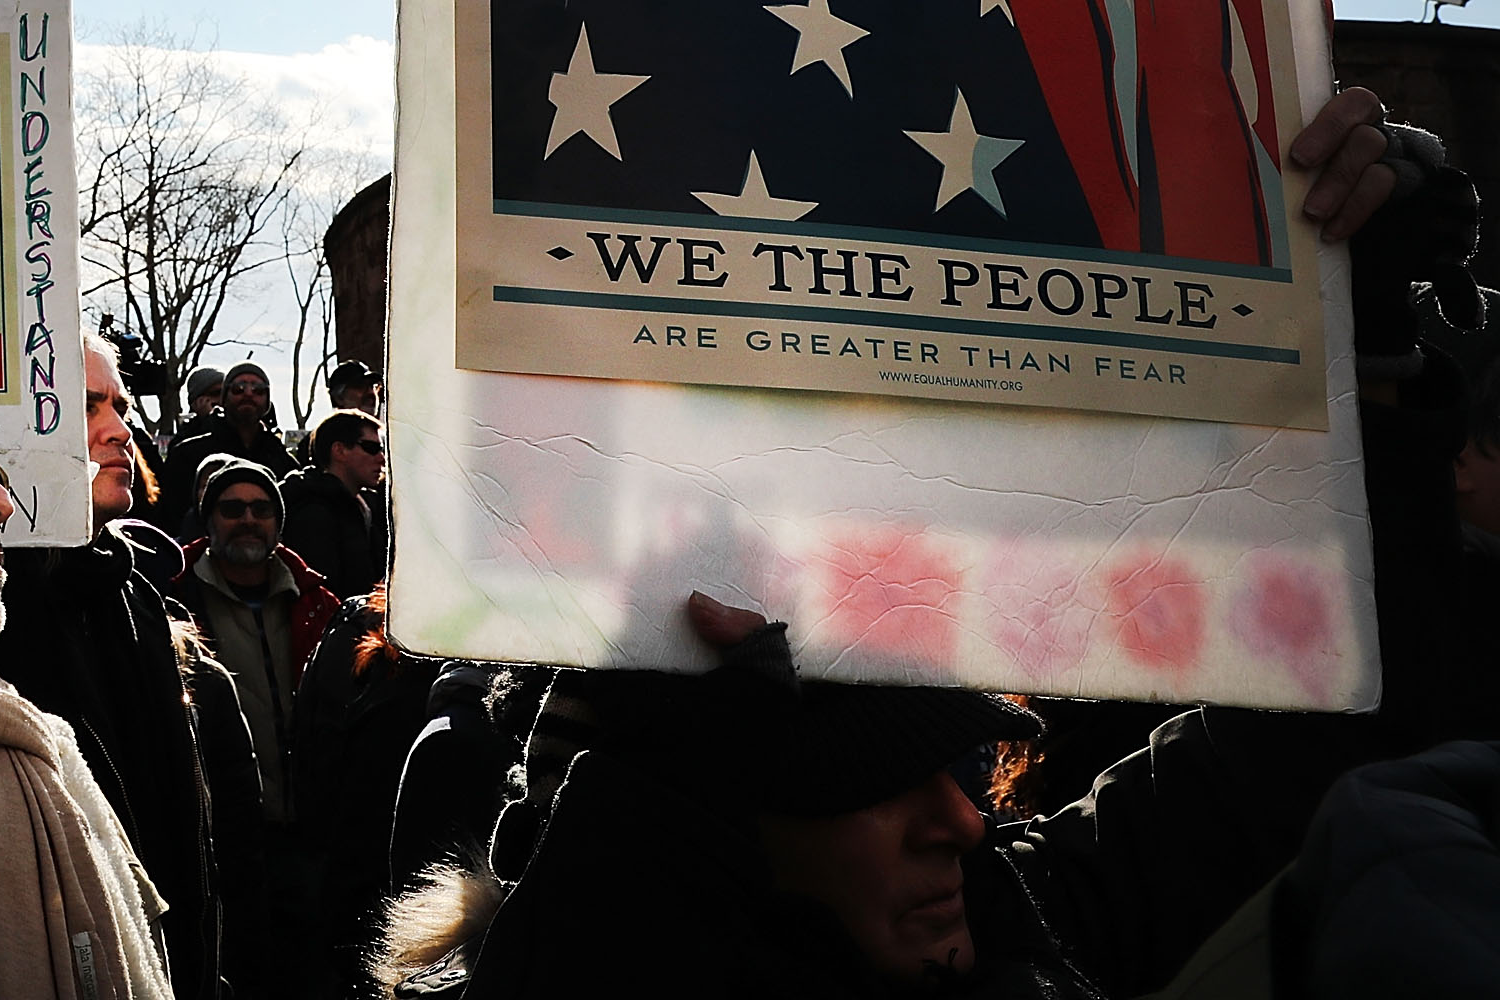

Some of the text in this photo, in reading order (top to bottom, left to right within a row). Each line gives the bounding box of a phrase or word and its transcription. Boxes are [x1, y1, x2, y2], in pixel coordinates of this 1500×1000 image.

[19, 12, 63, 437] UNDERSTAND
[586, 232, 1218, 329] WE THE PEOPLE
[633, 325, 1186, 385] ARE GREATER THAN FEAR
[878, 370, 1024, 391] WWW.EQUALHUMANITY.ORG
